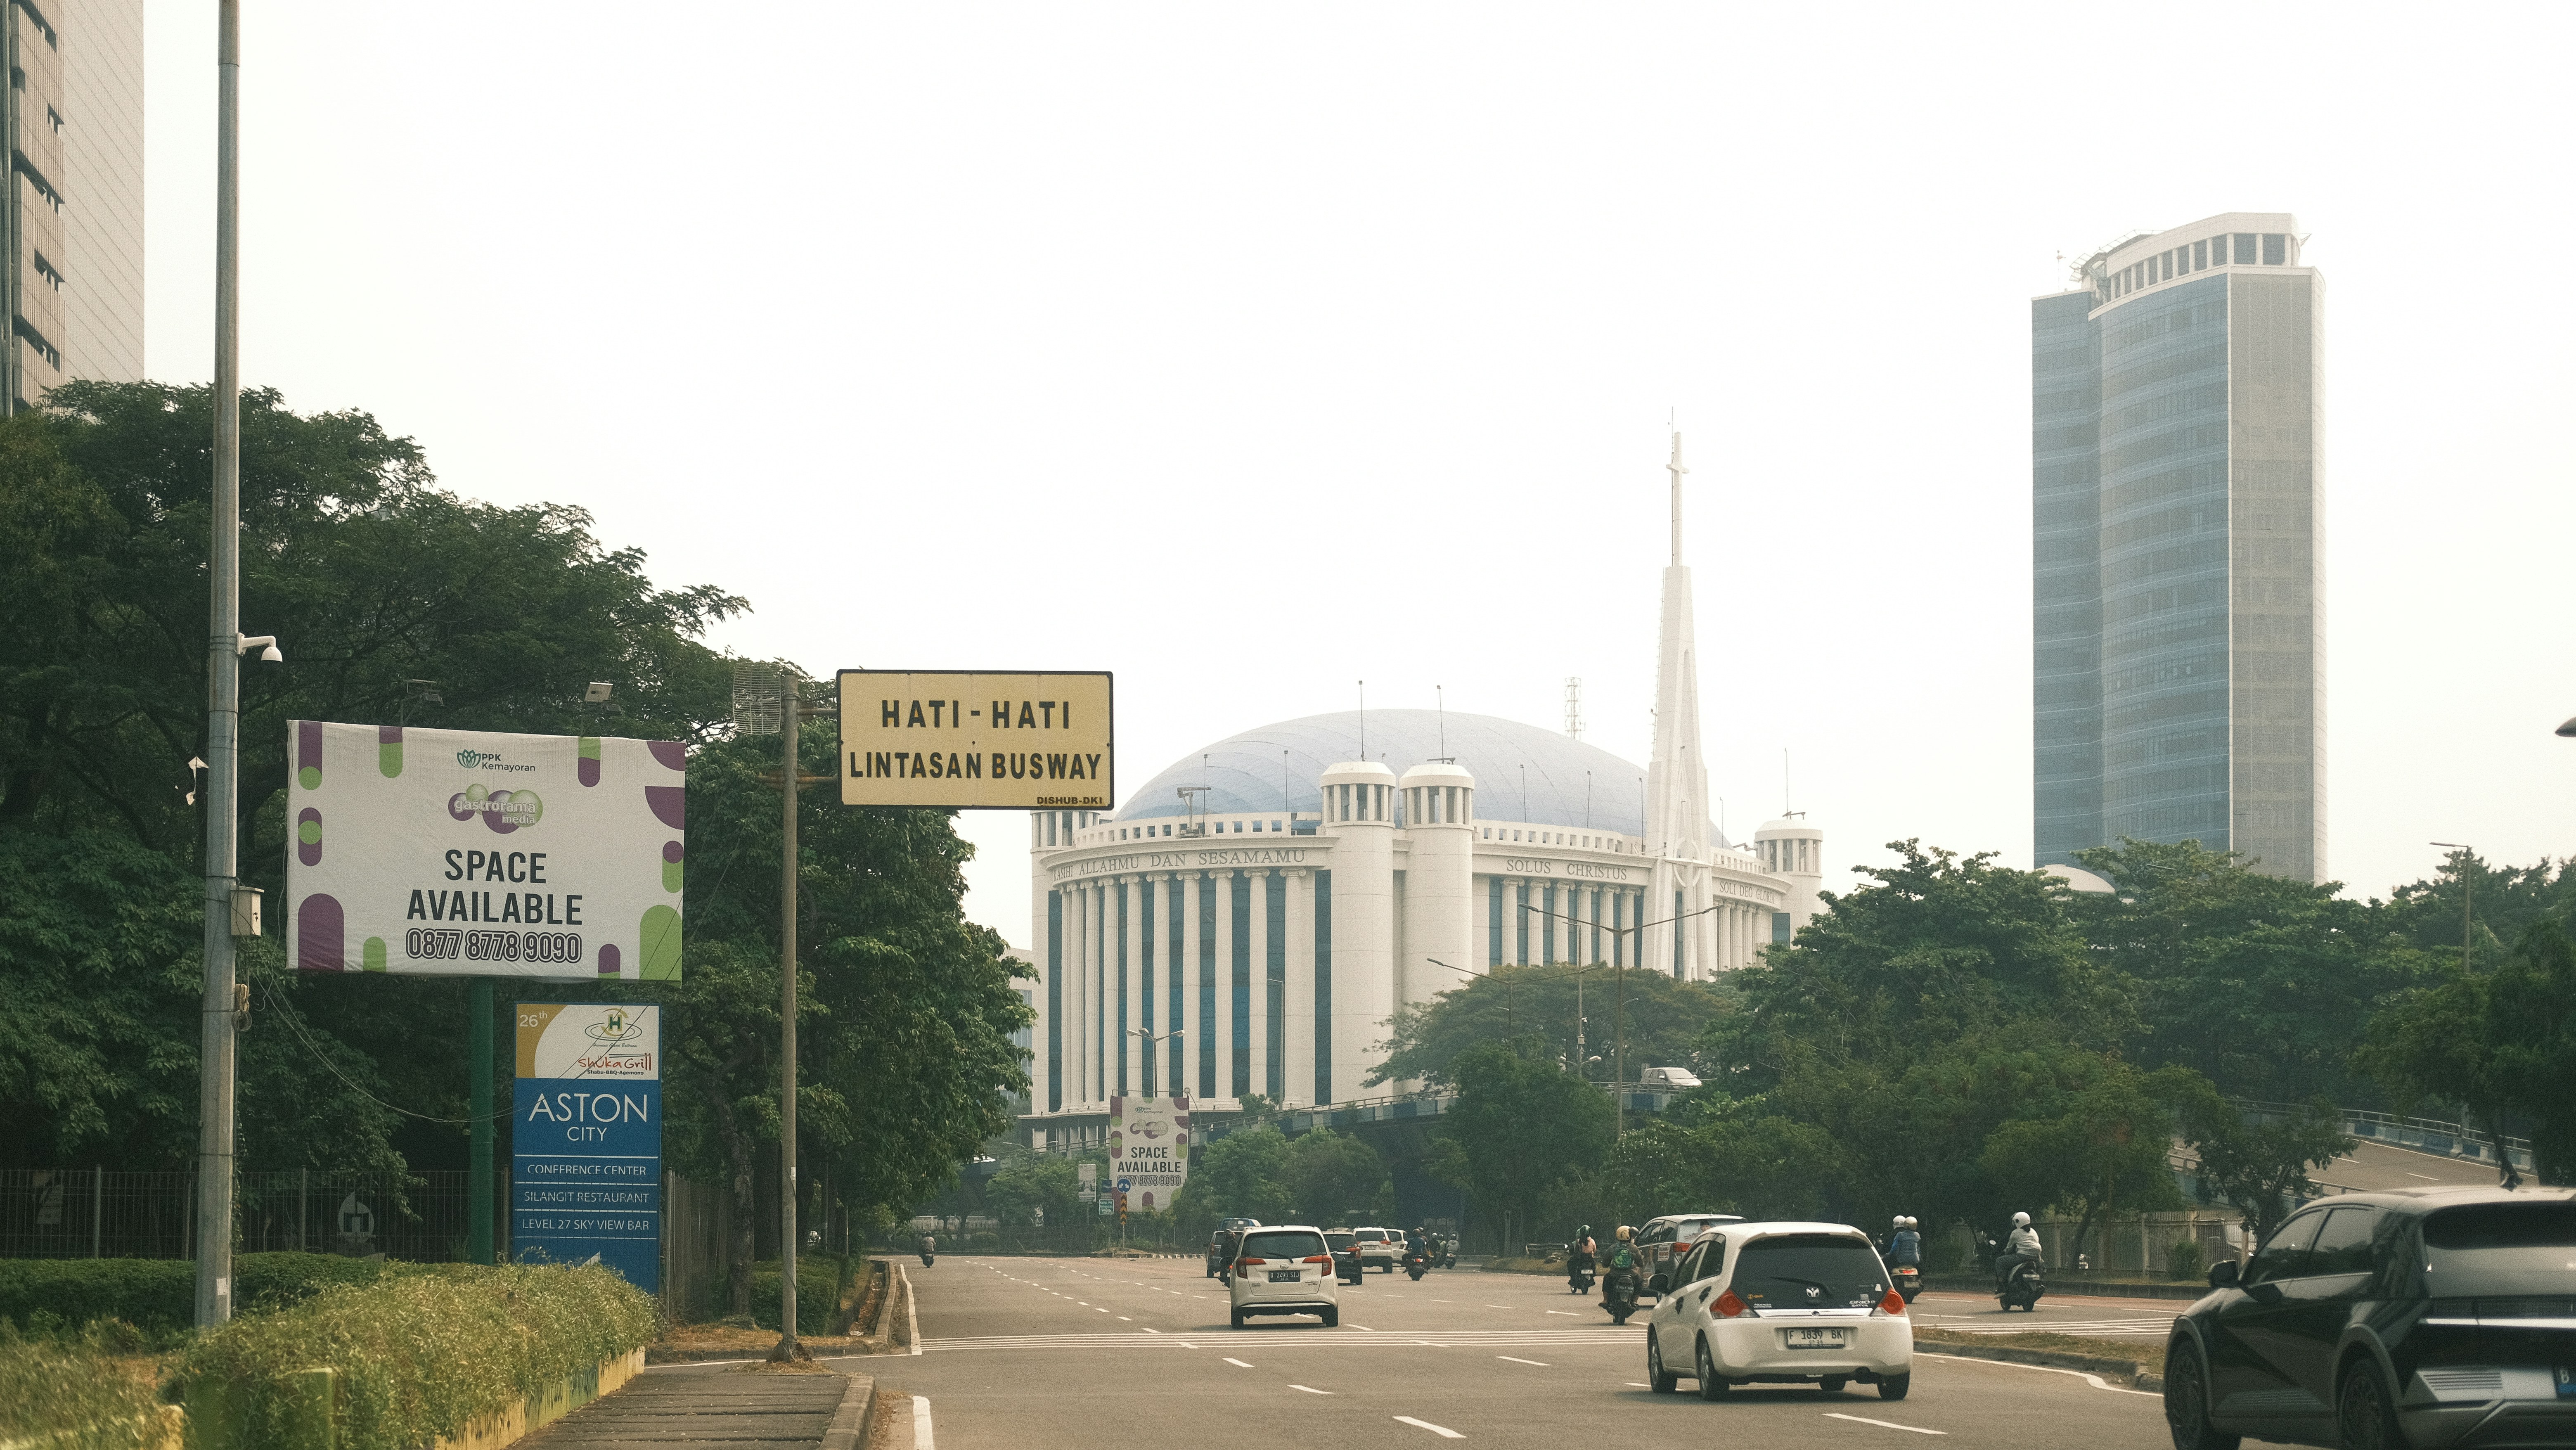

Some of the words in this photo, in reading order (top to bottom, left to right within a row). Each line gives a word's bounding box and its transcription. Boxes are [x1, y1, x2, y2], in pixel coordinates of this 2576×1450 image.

[482, 753, 501, 761] PPK
[482, 762, 535, 772] Kemayoran
[850, 752, 981, 779] LINTASAN
[992, 753, 1101, 779] BUSWAY
[454, 799, 536, 814] gastrorama
[1037, 796, 1103, 805] DISHUB-DKI
[502, 815, 535, 825] media
[445, 849, 547, 884] SPACE
[1054, 865, 1073, 881] KASIHI
[1079, 856, 1140, 876] ALLAHMU
[1151, 853, 1186, 867] DAN
[1198, 850, 1305, 865] SESAMAMU
[1506, 859, 1551, 874] SOLUS
[1567, 863, 1627, 880] CHRISTUS
[1719, 881, 1736, 895] SOLI
[1740, 884, 1753, 898] DEO
[1756, 887, 1776, 905] GLORIA
[407, 889, 582, 925] AVAILABLE
[406, 927, 462, 959] 0877
[465, 930, 519, 962] 8778
[523, 932, 582, 963] 9090
[519, 1010, 547, 1027] 26th
[624, 1053, 651, 1071] Grill
[528, 1092, 647, 1123] ASTON
[567, 1127, 607, 1142] CITY
[1131, 1147, 1168, 1159] SPACE
[528, 1164, 601, 1175] CONFERENCE
[604, 1166, 646, 1175] CENTER
[1118, 1161, 1181, 1173] AVAILABLE
[1138, 1175, 1158, 1186] 8778
[1159, 1175, 1181, 1186] 9090
[524, 1192, 575, 1202] SILANGIT
[578, 1192, 649, 1203] RESTAURANT
[523, 1219, 555, 1229] LEVEL
[558, 1220, 571, 1229] 27
[574, 1220, 595, 1230] SKY
[597, 1220, 625, 1230] VIEW
[628, 1220, 649, 1230] BAR
[1789, 1331, 1794, 1339] F
[1801, 1330, 1823, 1340] 1839
[1831, 1329, 1843, 1339] BK
